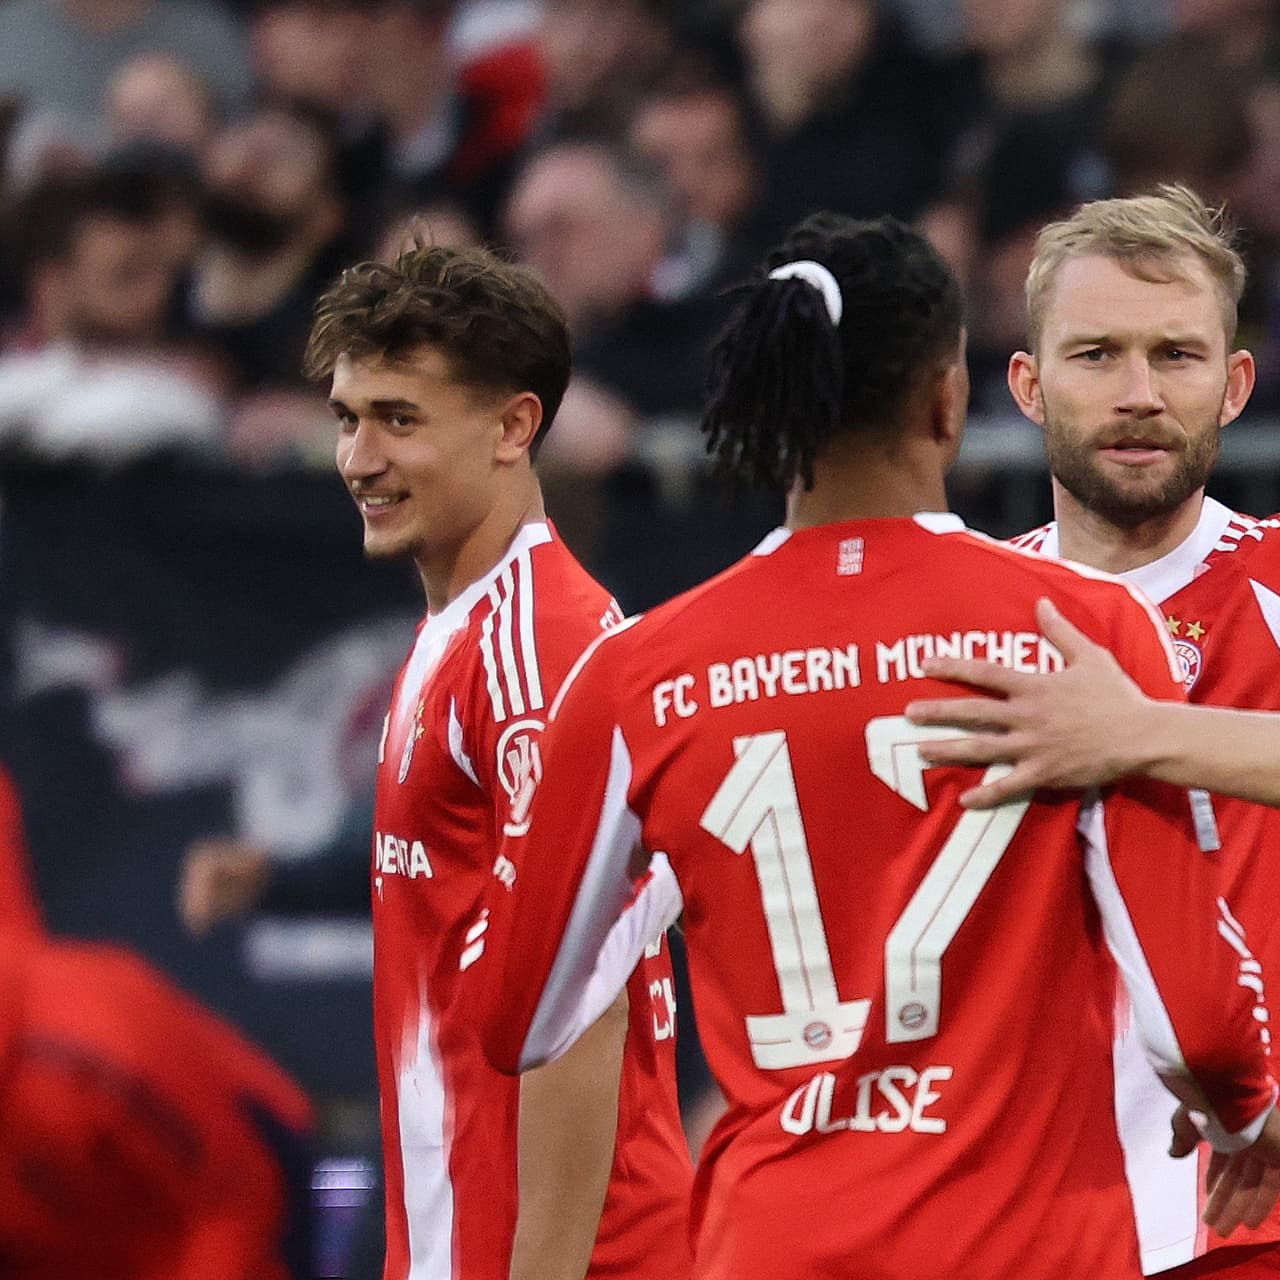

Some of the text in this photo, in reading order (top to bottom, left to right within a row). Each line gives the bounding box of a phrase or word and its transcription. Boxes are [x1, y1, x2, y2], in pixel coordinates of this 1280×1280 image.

[651, 673, 698, 728] FC
[707, 643, 860, 708] BAYERN
[699, 715, 1034, 1070] 17
[780, 1065, 953, 1135] OLISE
